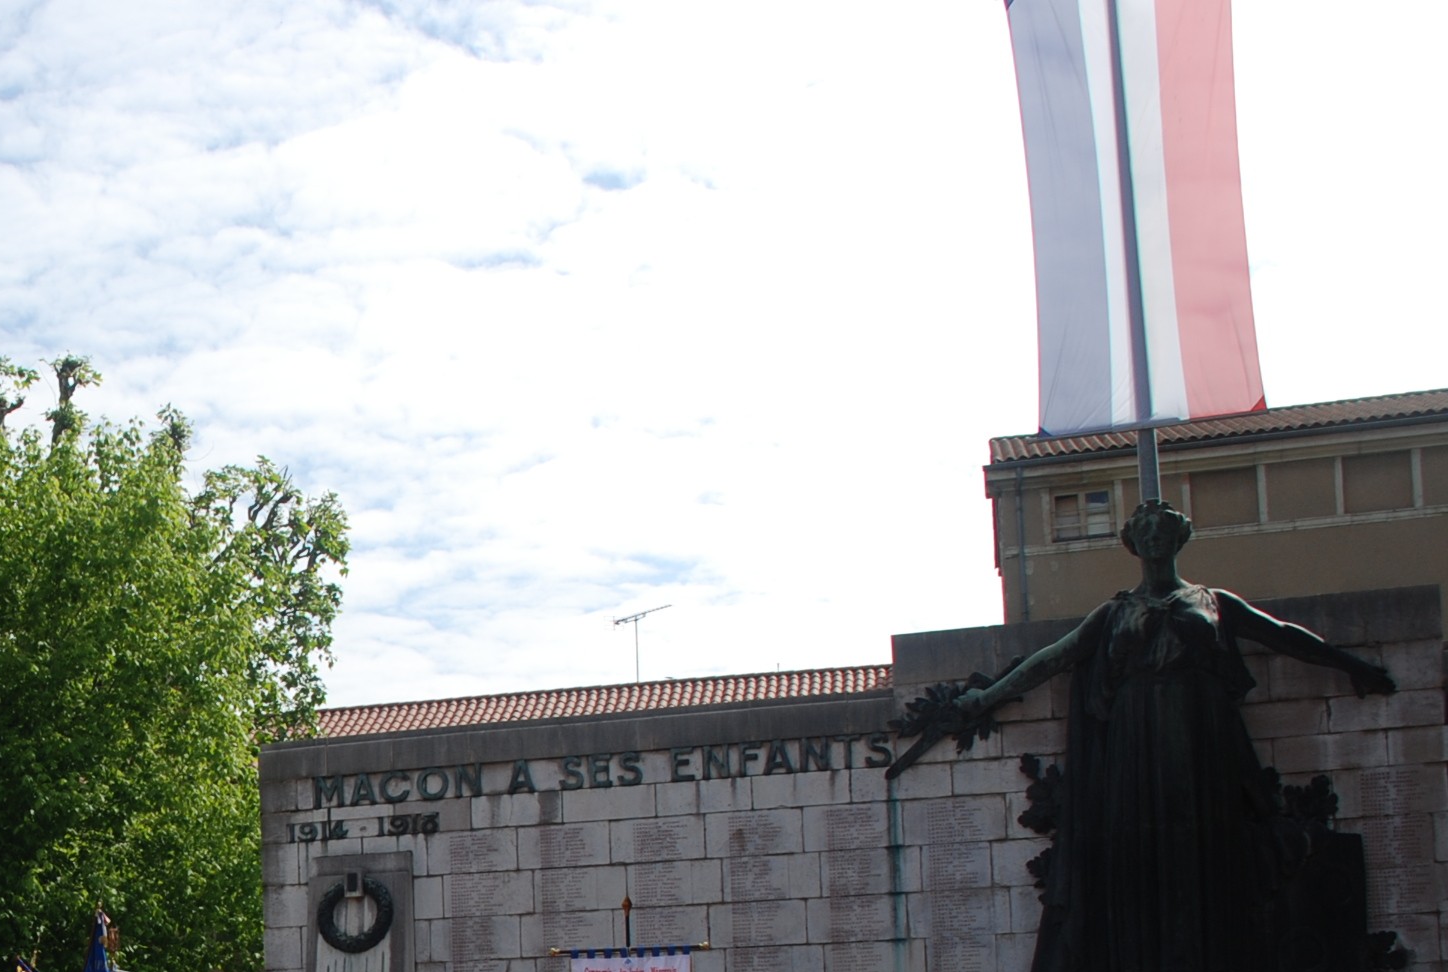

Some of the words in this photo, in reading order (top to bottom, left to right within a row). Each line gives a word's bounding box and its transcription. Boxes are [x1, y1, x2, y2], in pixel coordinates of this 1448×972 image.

[313, 762, 483, 809] MACON
[508, 759, 536, 794] A
[559, 752, 644, 790] SES
[670, 732, 894, 782] ENFANTS
[287, 818, 349, 843] 1914
[378, 811, 440, 837] 1918
